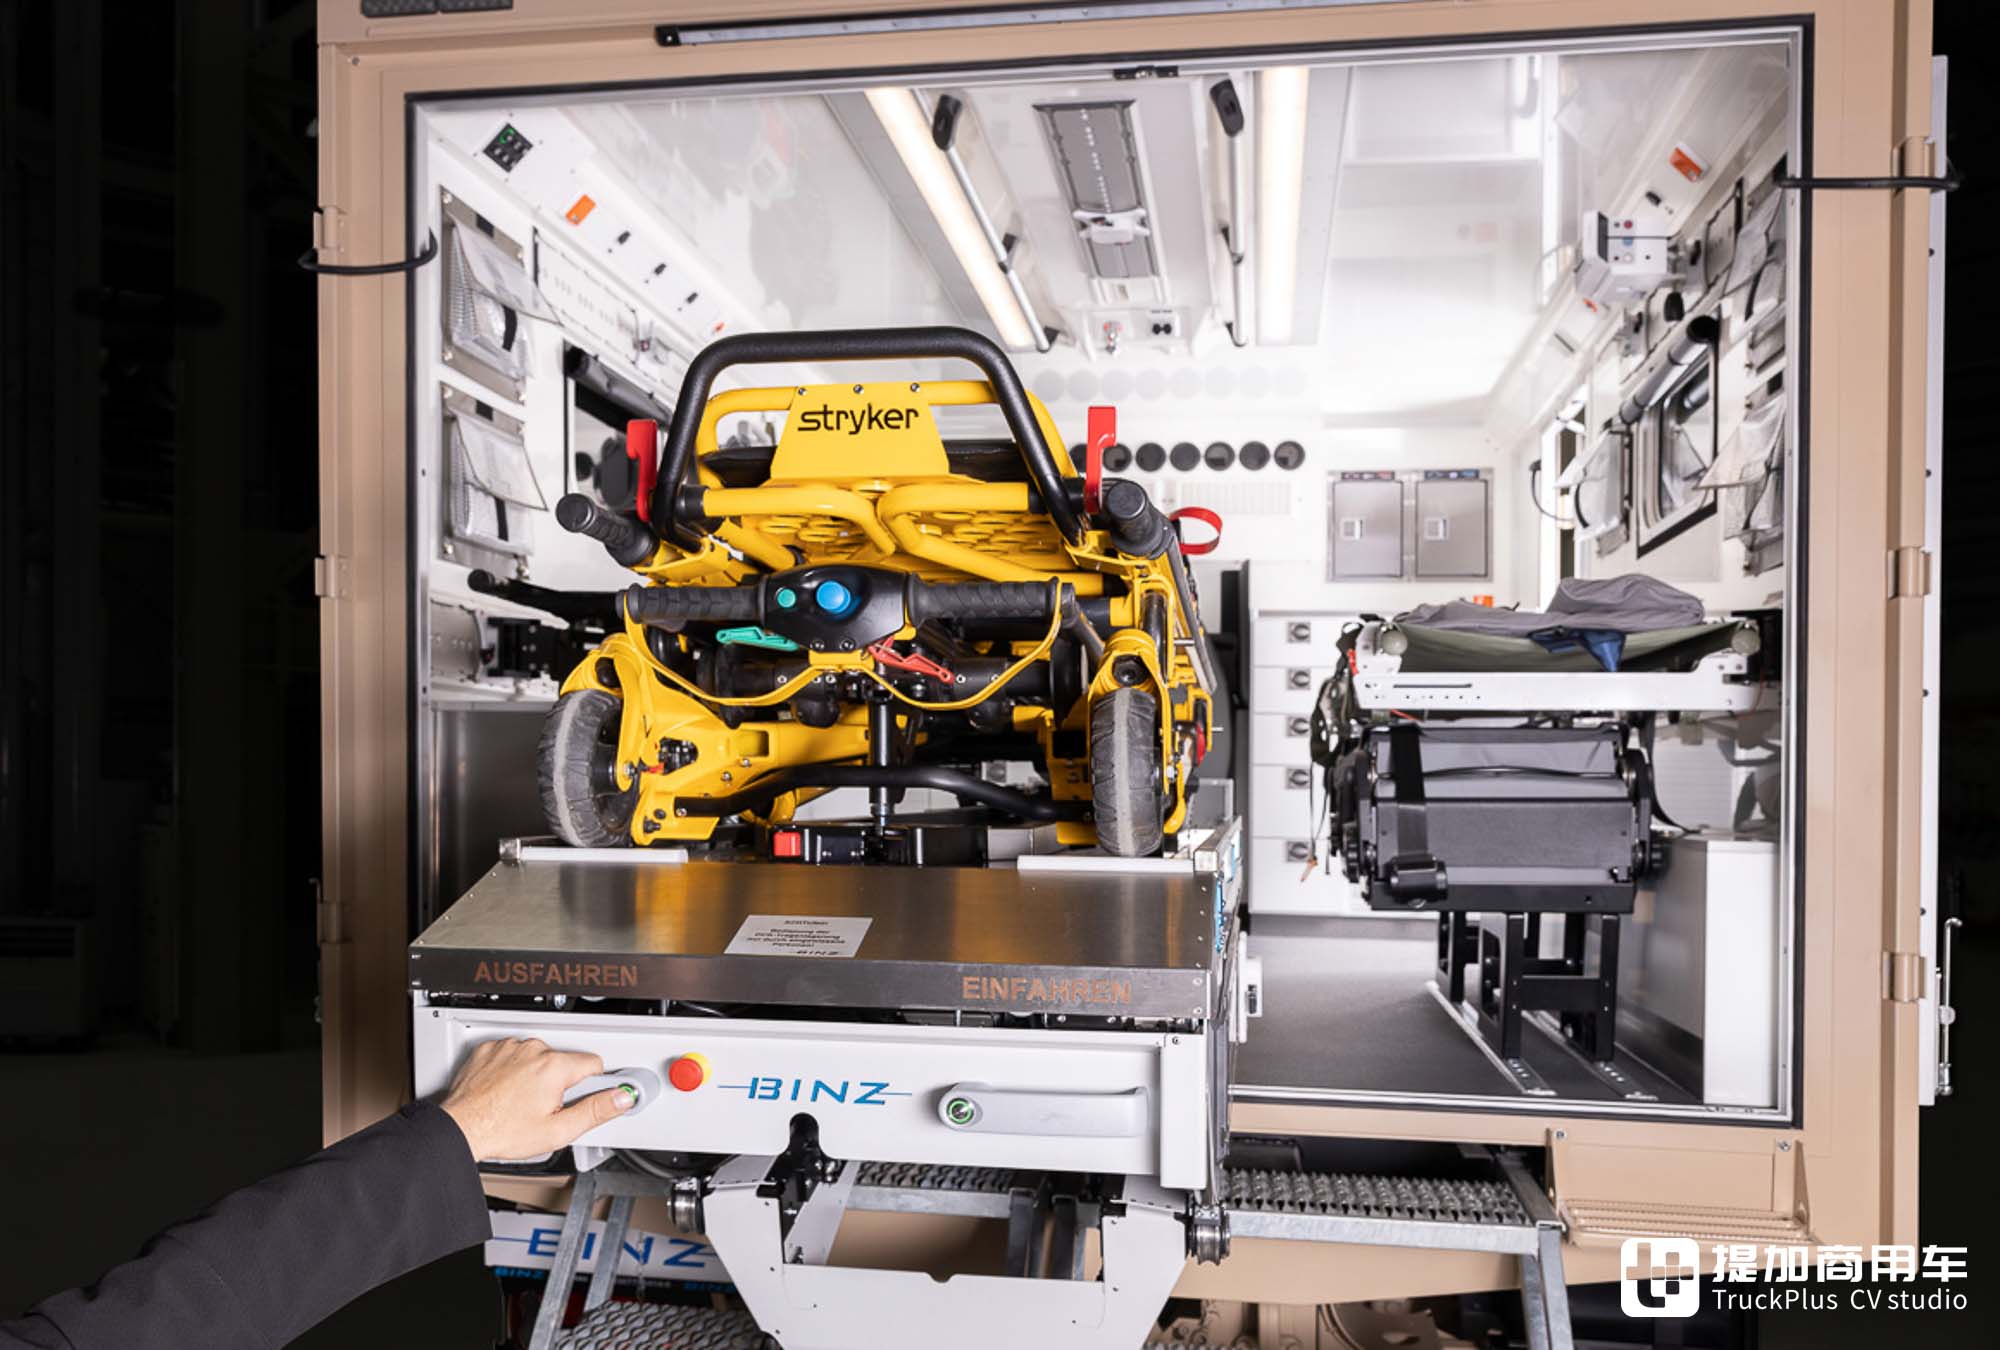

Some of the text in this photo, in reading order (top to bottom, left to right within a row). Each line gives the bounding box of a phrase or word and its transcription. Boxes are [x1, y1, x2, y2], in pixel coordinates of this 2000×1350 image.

[797, 402, 920, 435] stryker
[474, 961, 638, 987] AUSFAHREN
[962, 976, 1132, 1004] EINFAHREN
[748, 1077, 889, 1105] BINZ
